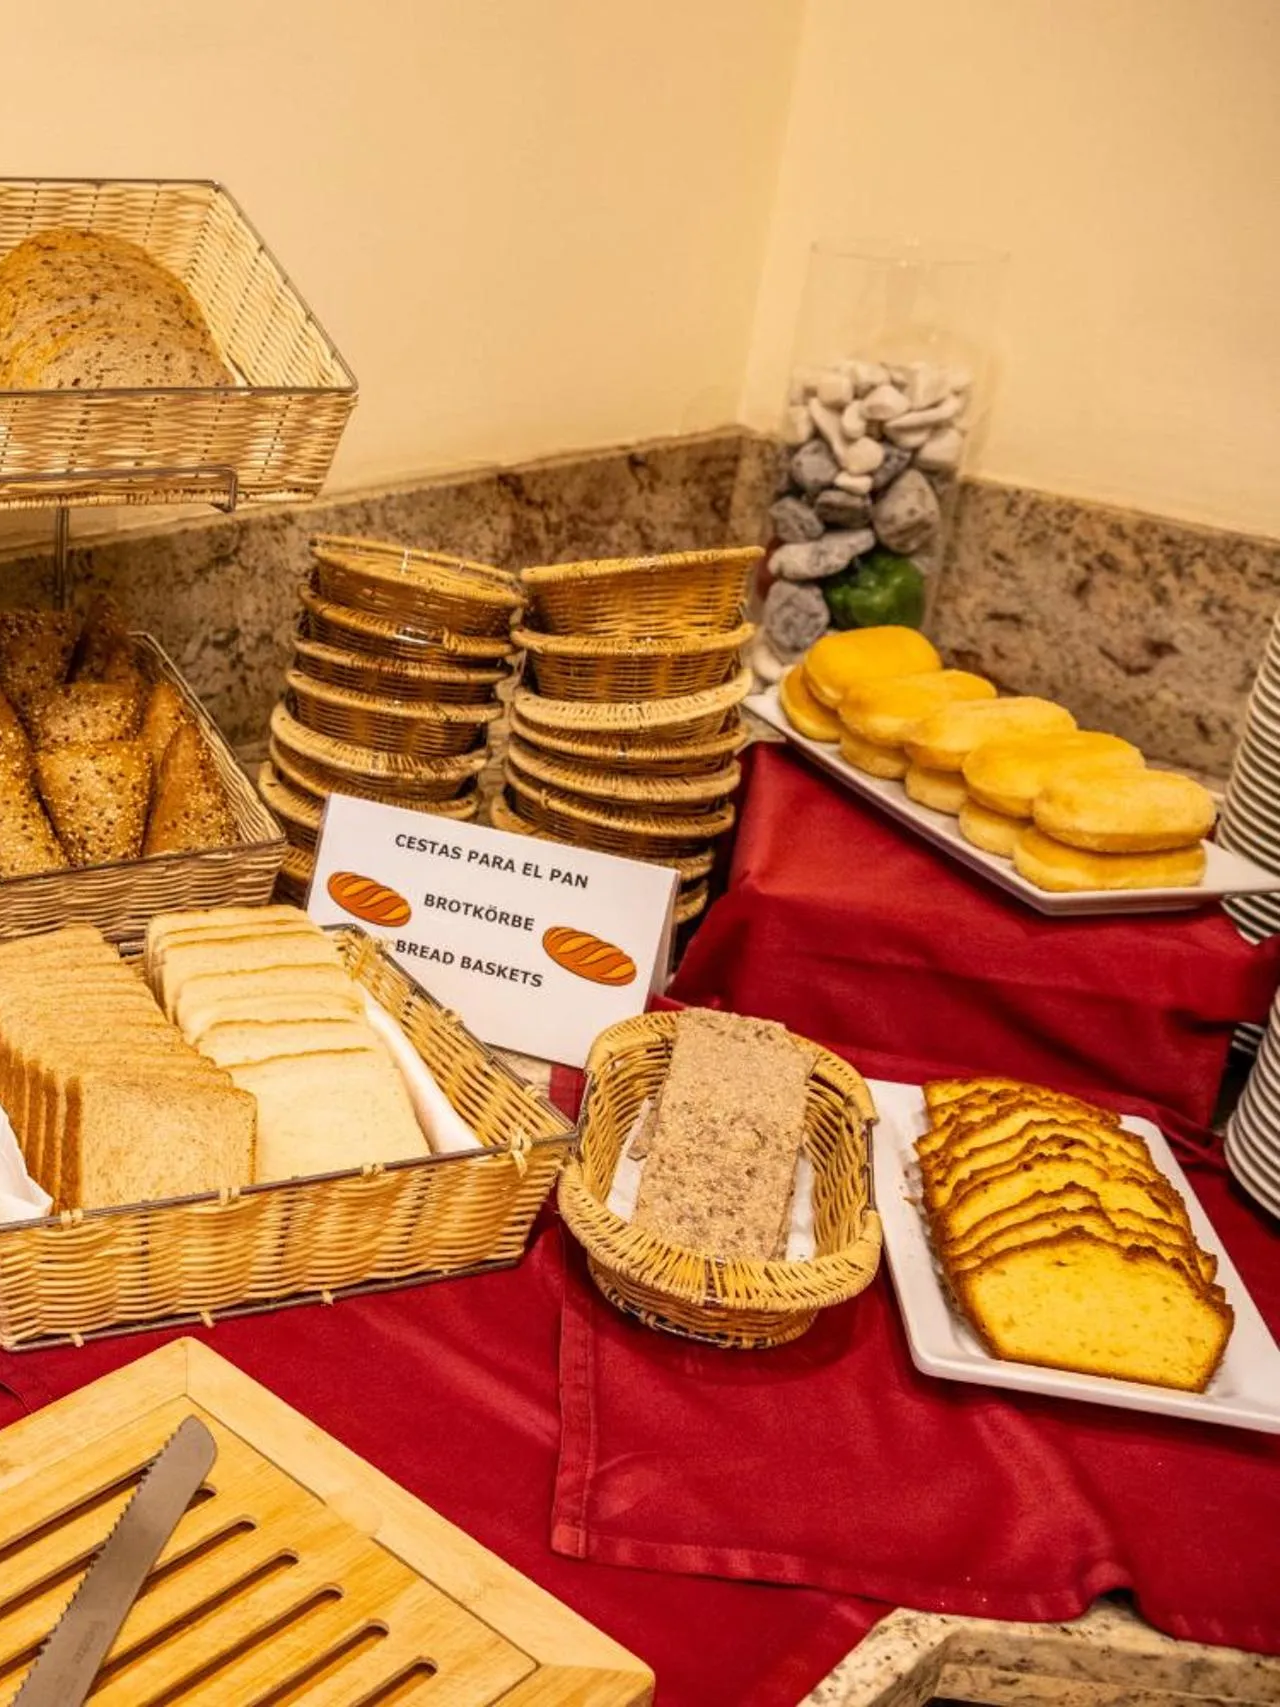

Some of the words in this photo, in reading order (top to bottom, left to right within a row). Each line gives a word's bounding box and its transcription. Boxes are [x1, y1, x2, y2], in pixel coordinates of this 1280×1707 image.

[395, 833, 462, 860] CESTAS
[467, 849, 516, 873] PARA
[522, 862, 543, 878] EL
[549, 868, 589, 889] PAN
[423, 893, 535, 931] BROTKÖRBE
[395, 939, 455, 965] BREAD
[460, 955, 544, 987] BASKETS
